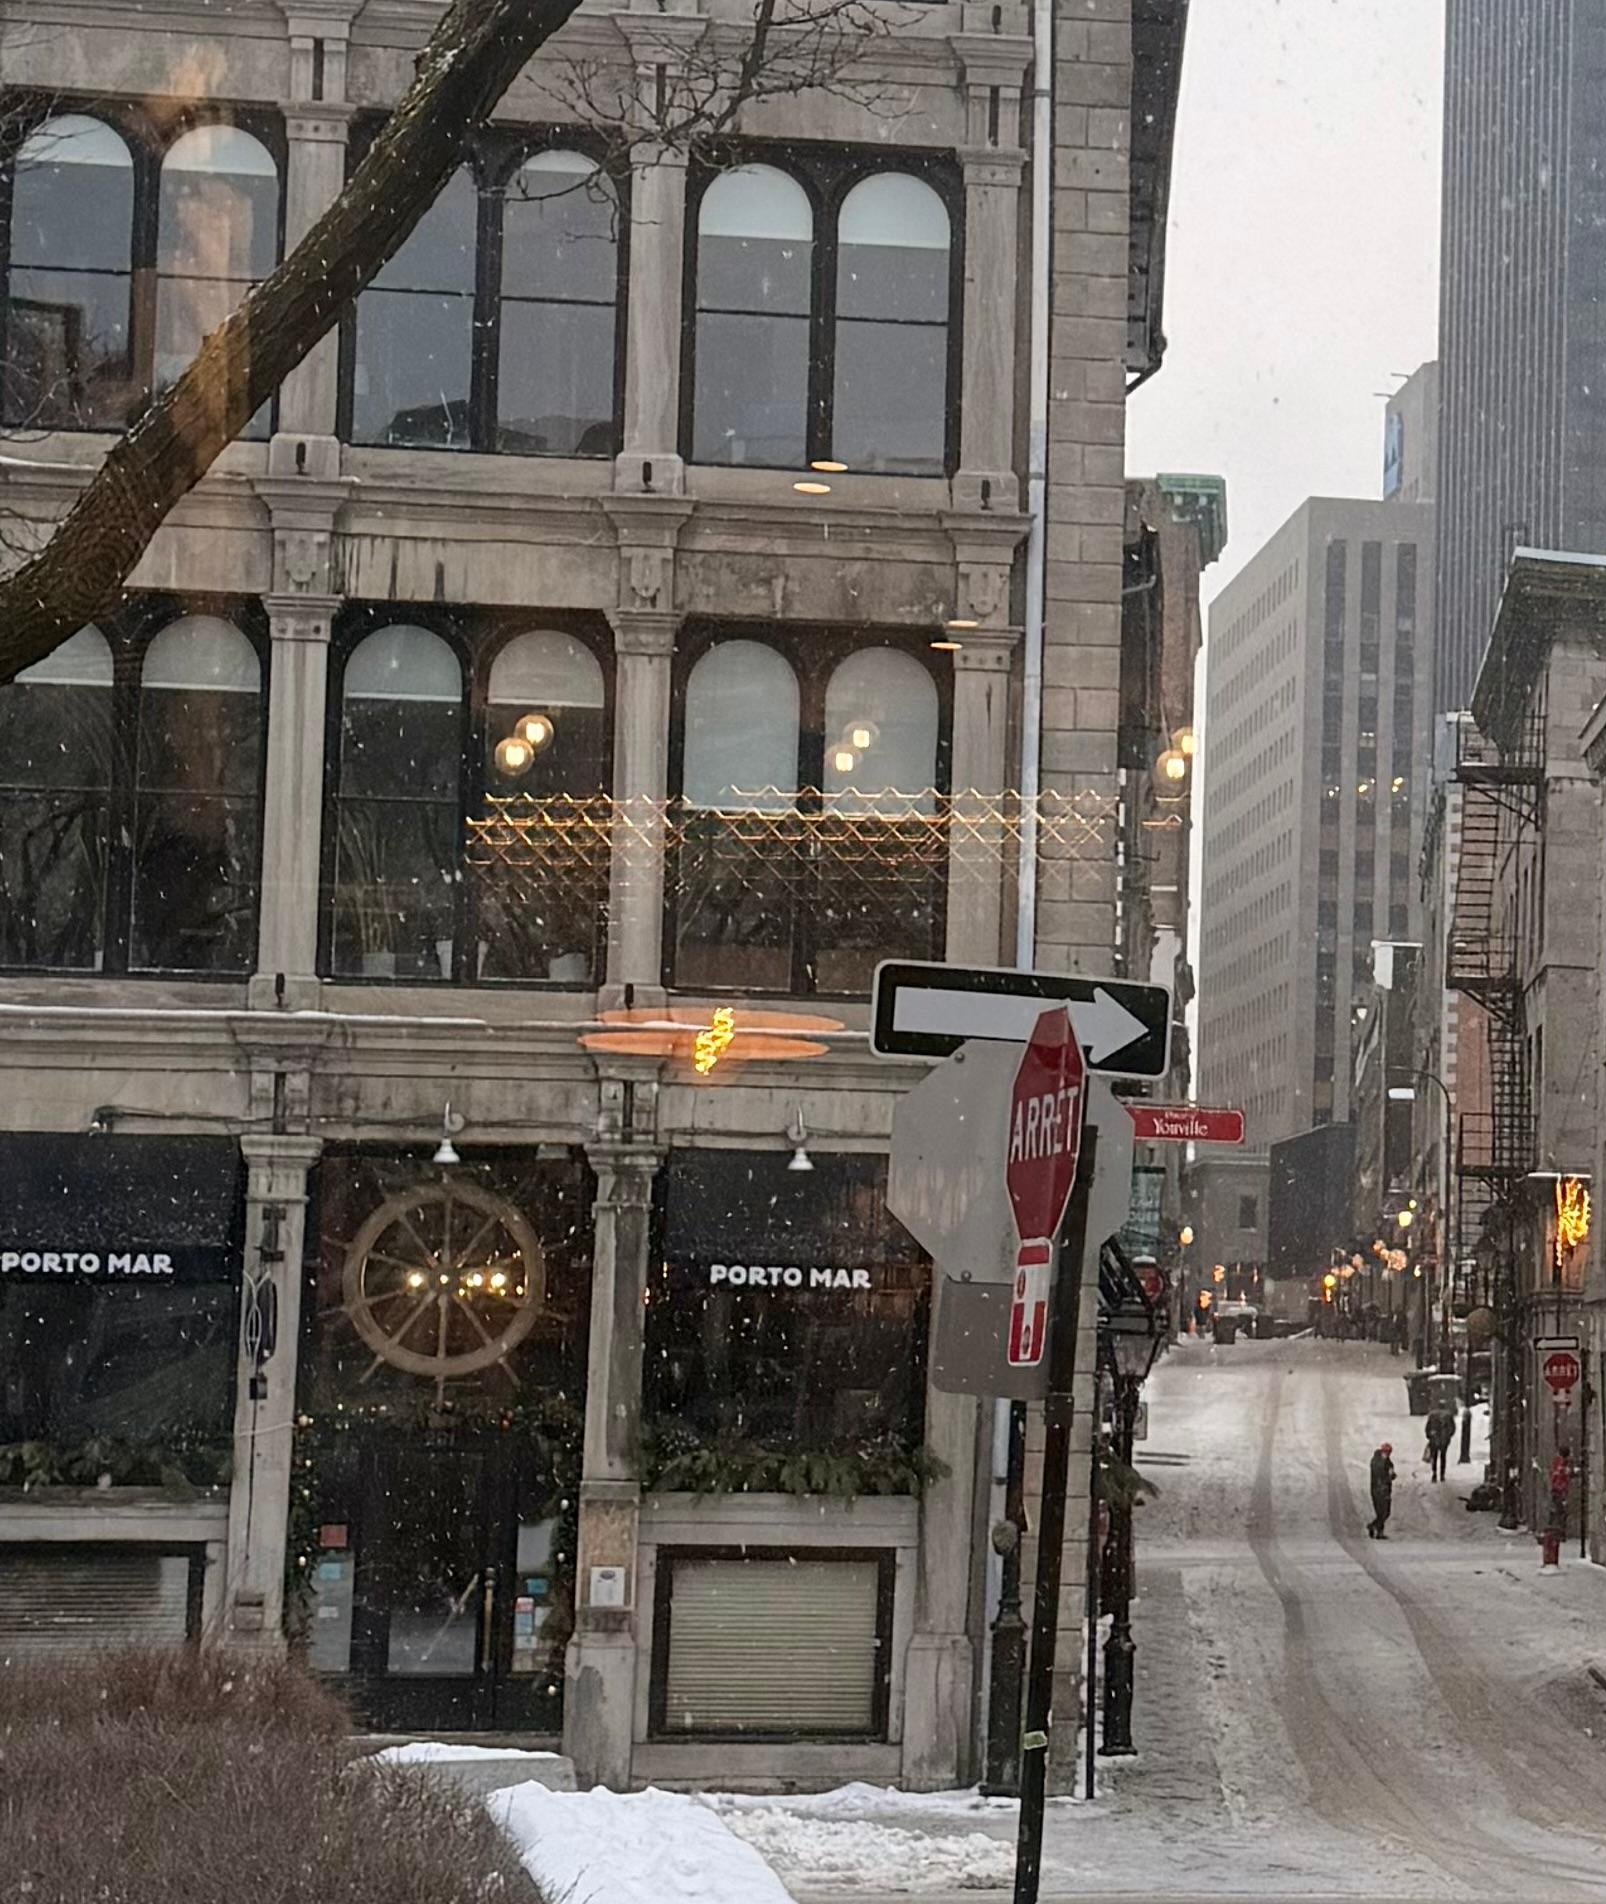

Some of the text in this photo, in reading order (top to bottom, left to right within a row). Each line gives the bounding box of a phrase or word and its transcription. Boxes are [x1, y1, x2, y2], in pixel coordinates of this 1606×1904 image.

[1153, 1117, 1209, 1136] Youville
[1, 1252, 174, 1274] PORTO MAR
[710, 1264, 872, 1289] PORTO MAR
